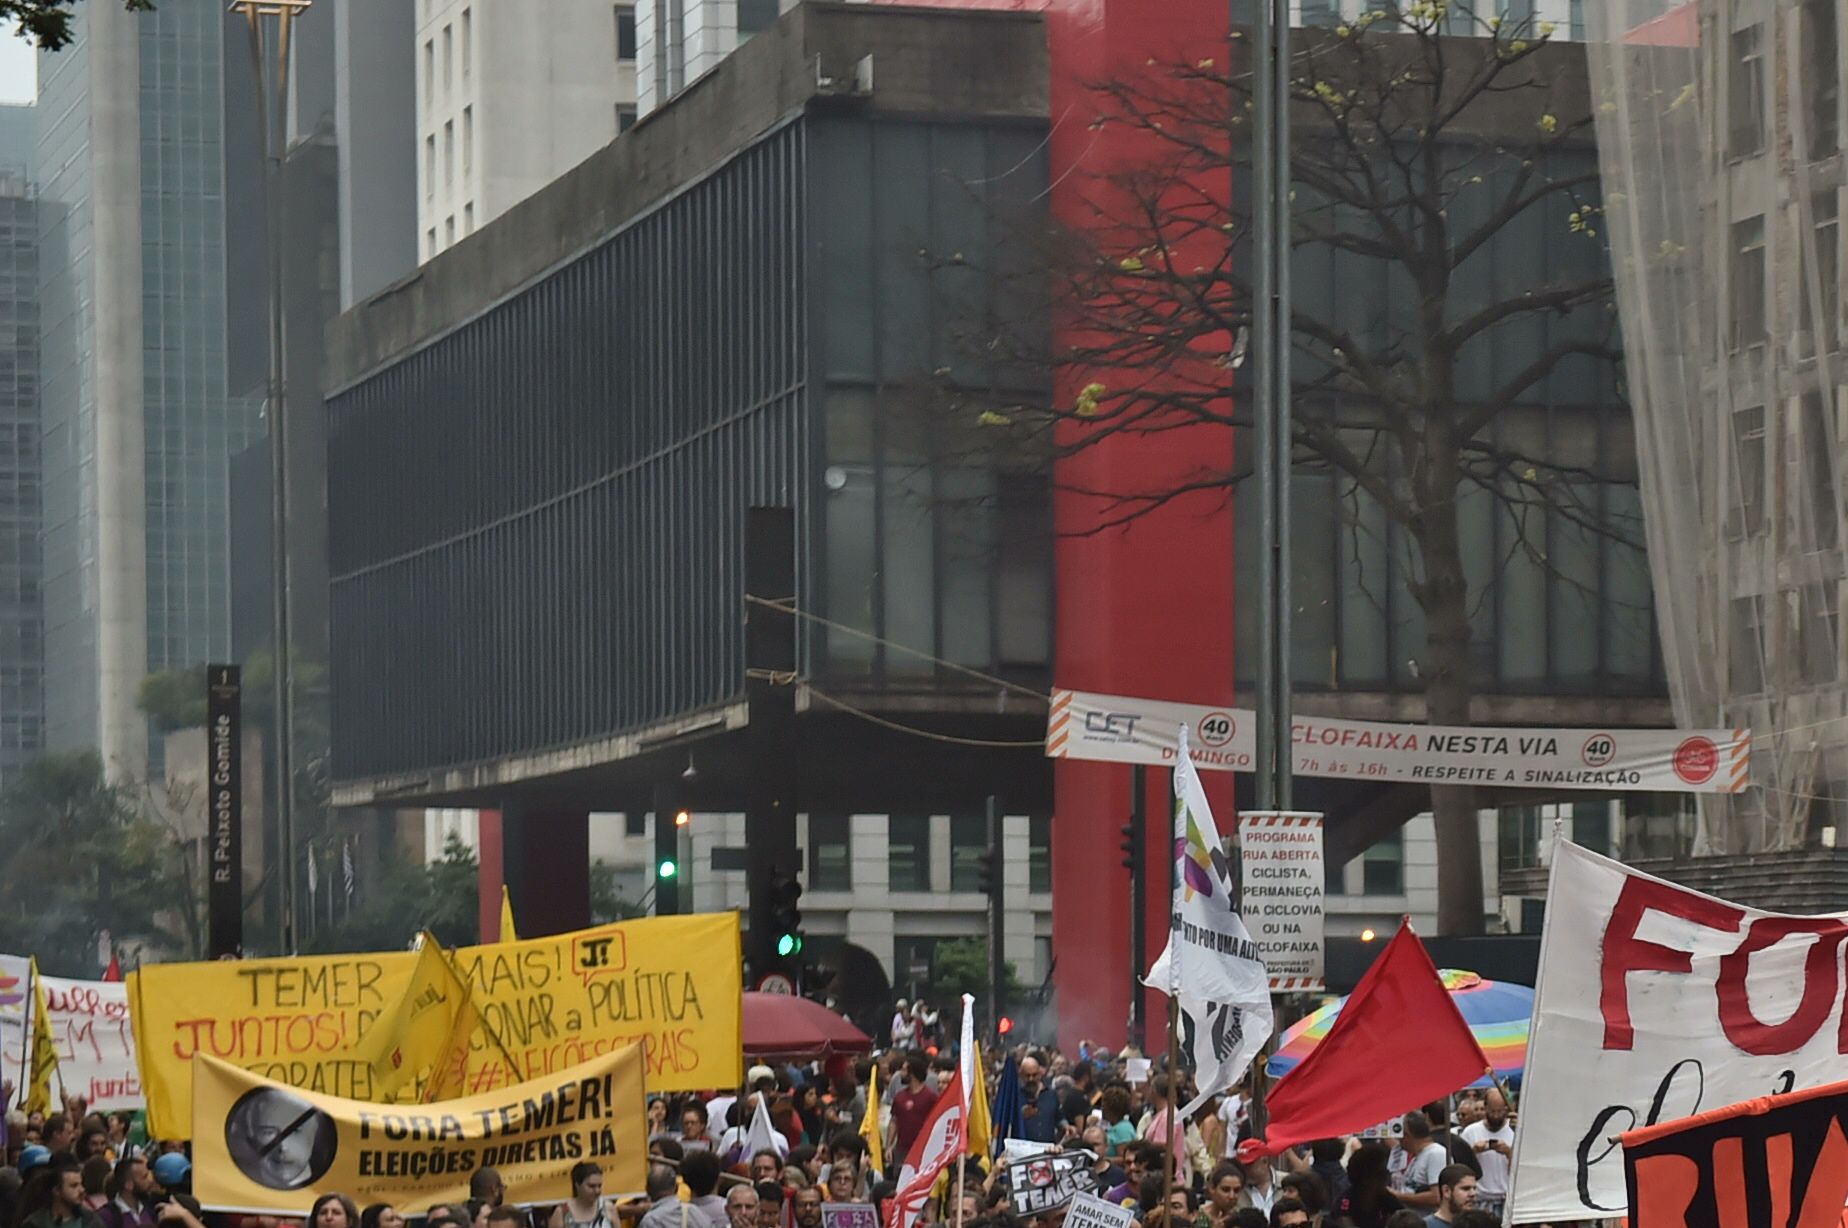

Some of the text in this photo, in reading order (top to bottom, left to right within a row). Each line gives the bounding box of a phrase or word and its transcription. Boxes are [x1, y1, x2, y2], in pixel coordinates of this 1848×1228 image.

[1202, 719, 1229, 735] 40
[1291, 723, 1558, 756] CLOFAIXA NESTA VIA
[1587, 740, 1611, 755] 40
[214, 714, 231, 786] Gomide
[1161, 747, 1250, 766] DMINGO
[1300, 758, 1319, 771] 7h
[1356, 761, 1388, 775] 16h
[1412, 765, 1497, 781] RESPEITE
[1504, 768, 1516, 782] A
[1524, 768, 1641, 786] SINALIZAÇÃO
[214, 789, 231, 860] Peixoto
[1246, 832, 1316, 843] PROGRAMA
[1243, 850, 1320, 861] RUA ABERTA
[1251, 867, 1312, 880] CICLISTA,
[1243, 886, 1321, 899] PERMANEÇA
[1243, 904, 1322, 916] NA CICLOVIA
[1262, 923, 1302, 934] OU NA
[1217, 932, 1239, 957] UMA
[1257, 941, 1320, 953] CLOFAIXA
[237, 961, 384, 1009] TEMER
[173, 1010, 349, 1061] JUNTOS!
[566, 1010, 582, 1031] a
[587, 968, 703, 1028] POLÍTICA
[358, 1110, 465, 1142] FORA
[472, 1073, 614, 1140] TEMER!
[358, 1124, 617, 1181] ELEIÇÕES DIRETAS JÁ
[1013, 1170, 1094, 1213] TEMER
[1075, 1204, 1103, 1220] AMAR
